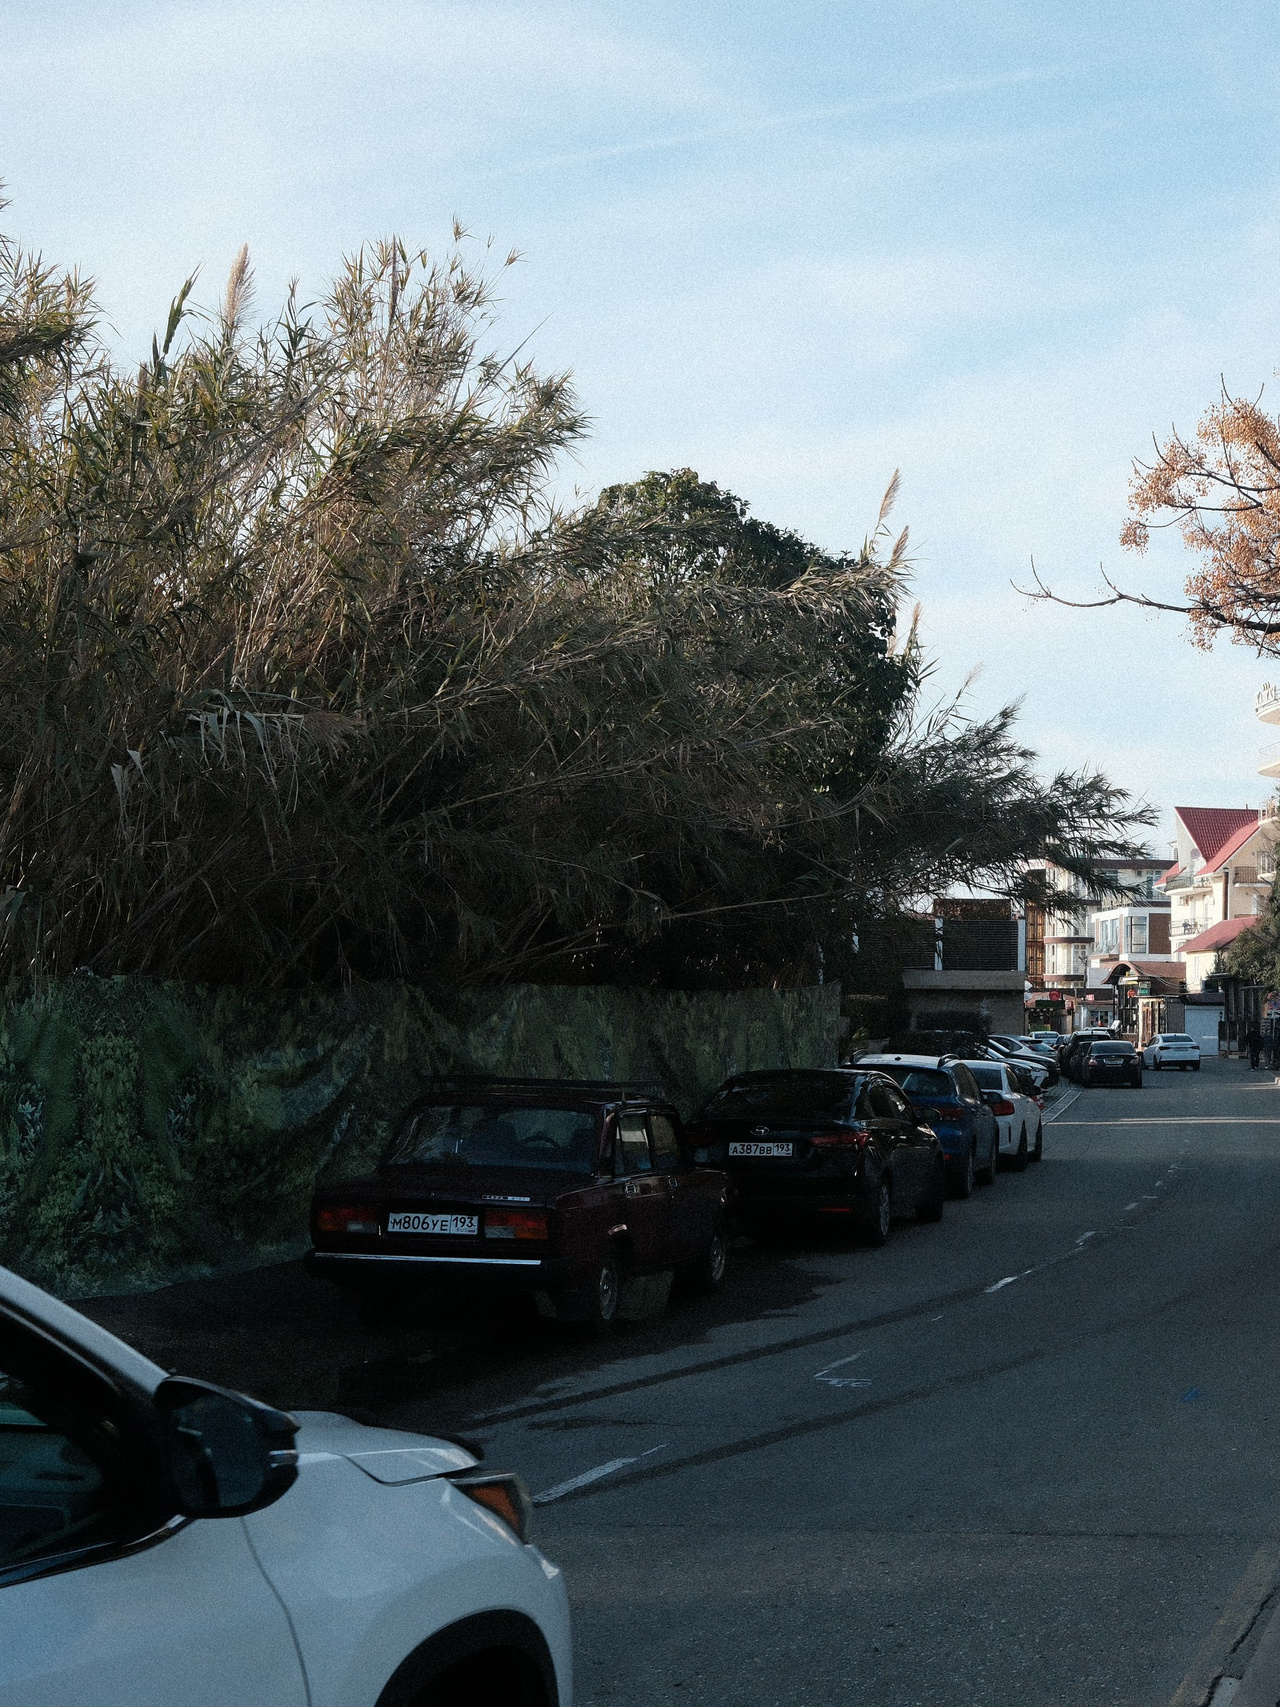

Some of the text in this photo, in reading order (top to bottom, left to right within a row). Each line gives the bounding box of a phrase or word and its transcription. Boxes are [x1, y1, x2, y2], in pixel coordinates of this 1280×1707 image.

[732, 1143, 790, 1155] А387ВВ 193
[392, 1215, 475, 1231] М806УЕ 193
